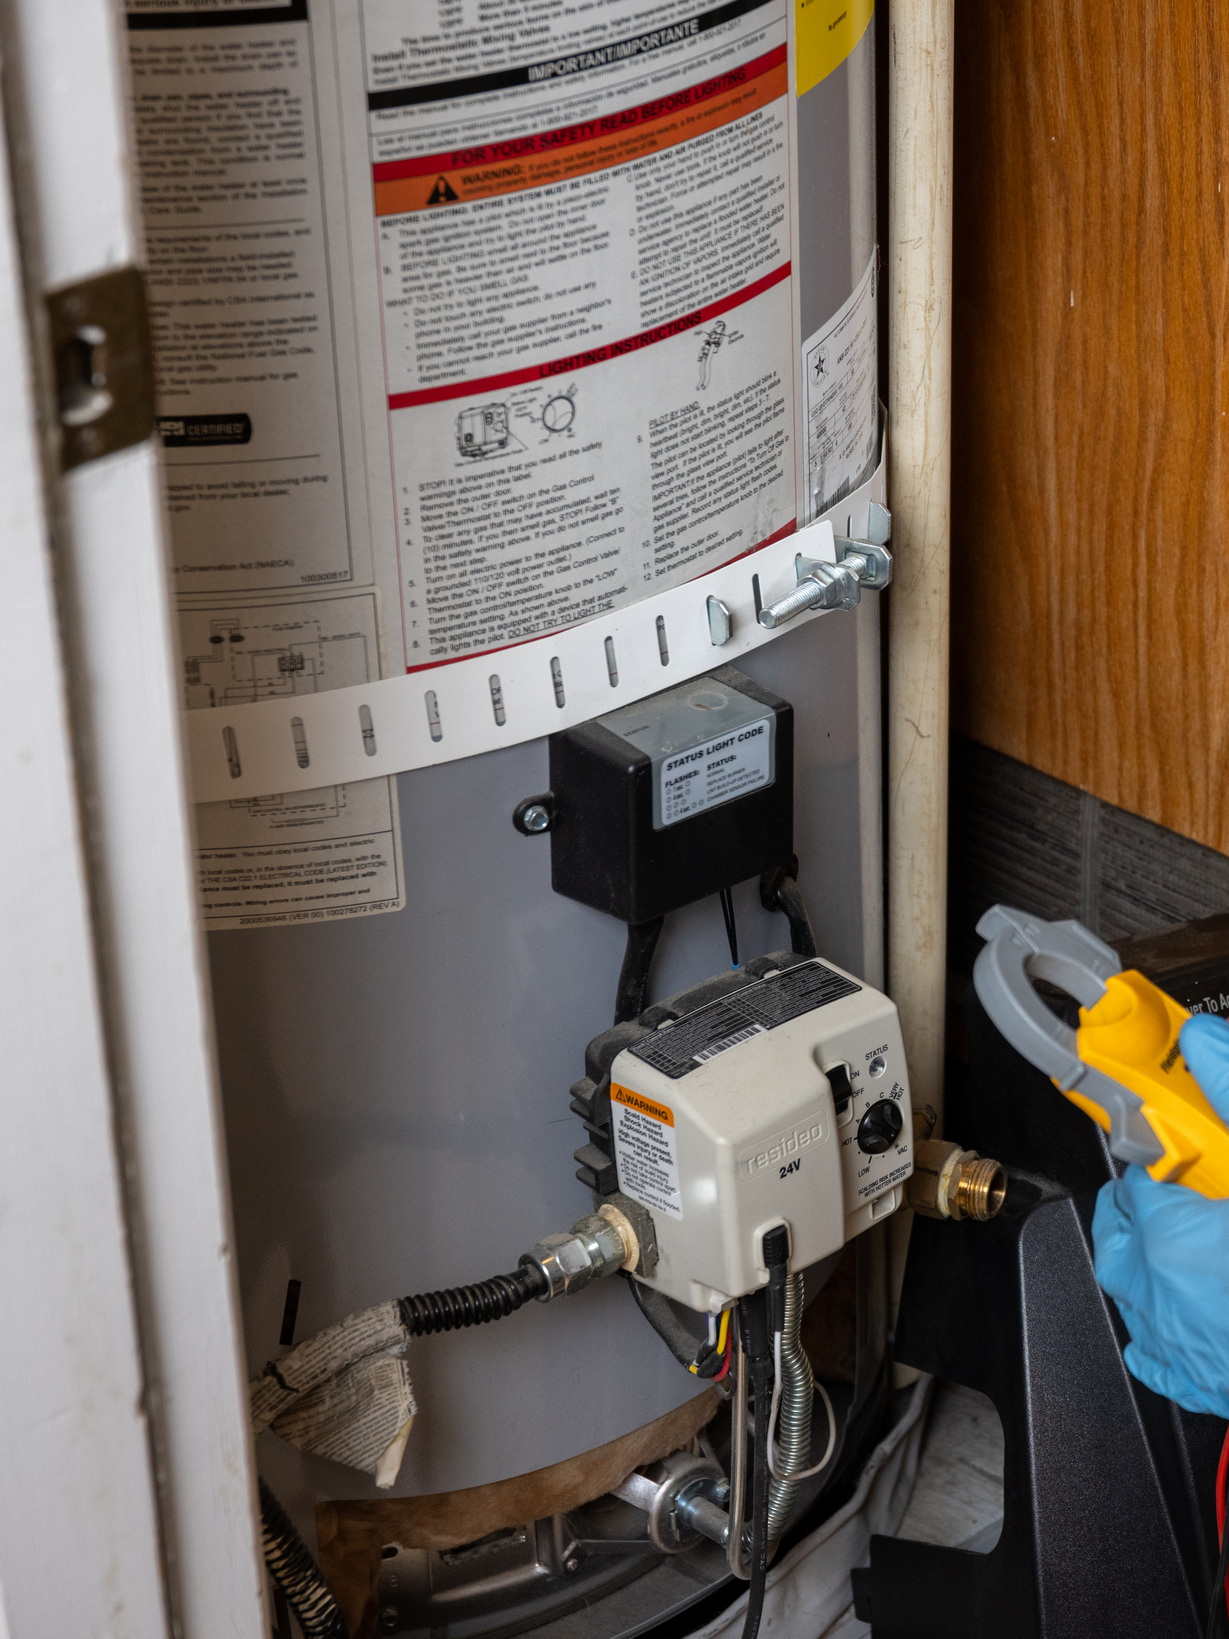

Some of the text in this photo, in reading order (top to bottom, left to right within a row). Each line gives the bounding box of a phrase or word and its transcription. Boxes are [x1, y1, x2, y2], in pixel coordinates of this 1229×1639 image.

[452, 68, 745, 165] FOR YOUR SAFETY READ BEFORE LIGHTING
[508, 191, 541, 204] SYSTEM
[545, 184, 567, 196] MUST
[569, 182, 580, 190] BE
[582, 172, 609, 185] FILLED
[612, 167, 630, 177] WITH
[632, 157, 656, 170] WATER
[659, 151, 673, 161] AND
[675, 146, 686, 155] AIR
[688, 134, 714, 149] PURGED
[716, 126, 733, 137] FROM
[735, 122, 746, 130] ALL
[747, 111, 762, 125] LINES
[540, 348, 606, 377] LIGHTING
[611, 311, 701, 356] INSTRUCTIONS
[465, 469, 505, 482] imperative
[507, 464, 522, 473] that
[524, 461, 537, 470] you
[540, 455, 556, 464] read
[558, 451, 566, 460] all
[581, 442, 602, 453] safety
[421, 514, 443, 522] Move
[460, 507, 474, 515] ON
[481, 500, 498, 510] OFF
[501, 495, 524, 506] switch
[551, 484, 567, 492] Gas
[568, 474, 594, 488] Control
[655, 551, 679, 565] Replace
[680, 546, 689, 554] the
[691, 538, 705, 549] outer
[655, 567, 665, 577] Set
[667, 553, 698, 572] thermostat
[705, 538, 724, 553] desired
[725, 529, 743, 543] setting.
[666, 725, 764, 771] STATUS LIGHT CODE
[706, 755, 737, 771] STATUS:
[706, 768, 725, 778] NORMAL
[665, 770, 700, 788] FLASHES:
[706, 767, 746, 786] REPLACE BURNER
[706, 786, 717, 795] LINT
[737, 768, 760, 782] DETECTED
[706, 774, 765, 802] CHAMBER SENSOR FAILURE
[369, 902, 389, 912] (REV
[389, 900, 400, 909] A)
[1186, 1003, 1203, 1015] ver
[1203, 996, 1219, 1014] To
[865, 1044, 889, 1061] STATUS
[850, 1070, 860, 1080] ON
[851, 1087, 865, 1099] OFF
[879, 1091, 885, 1099] C
[889, 1081, 900, 1098] VERY
[896, 1087, 905, 1101] HOT
[625, 1094, 668, 1120] WARNING
[865, 1101, 871, 1109] B
[624, 1108, 661, 1130] Scald Hazard
[624, 1115, 663, 1138] Shock Hazard
[618, 1128, 671, 1158] High voltage present.
[620, 1120, 668, 1147] Explosion Hazard
[841, 1136, 853, 1147] HOT
[618, 1135, 635, 1148] Severe
[637, 1144, 650, 1156] injury
[658, 1155, 673, 1165] death
[747, 1123, 823, 1174] resideo
[897, 1145, 908, 1155] VAC
[643, 1155, 659, 1166] result.
[779, 1158, 801, 1179] 24V
[857, 1166, 871, 1178] LOW
[857, 1161, 912, 1196] SCALDING RISK INCREASES
[864, 1170, 907, 1198] WITH HOTTER WATER
